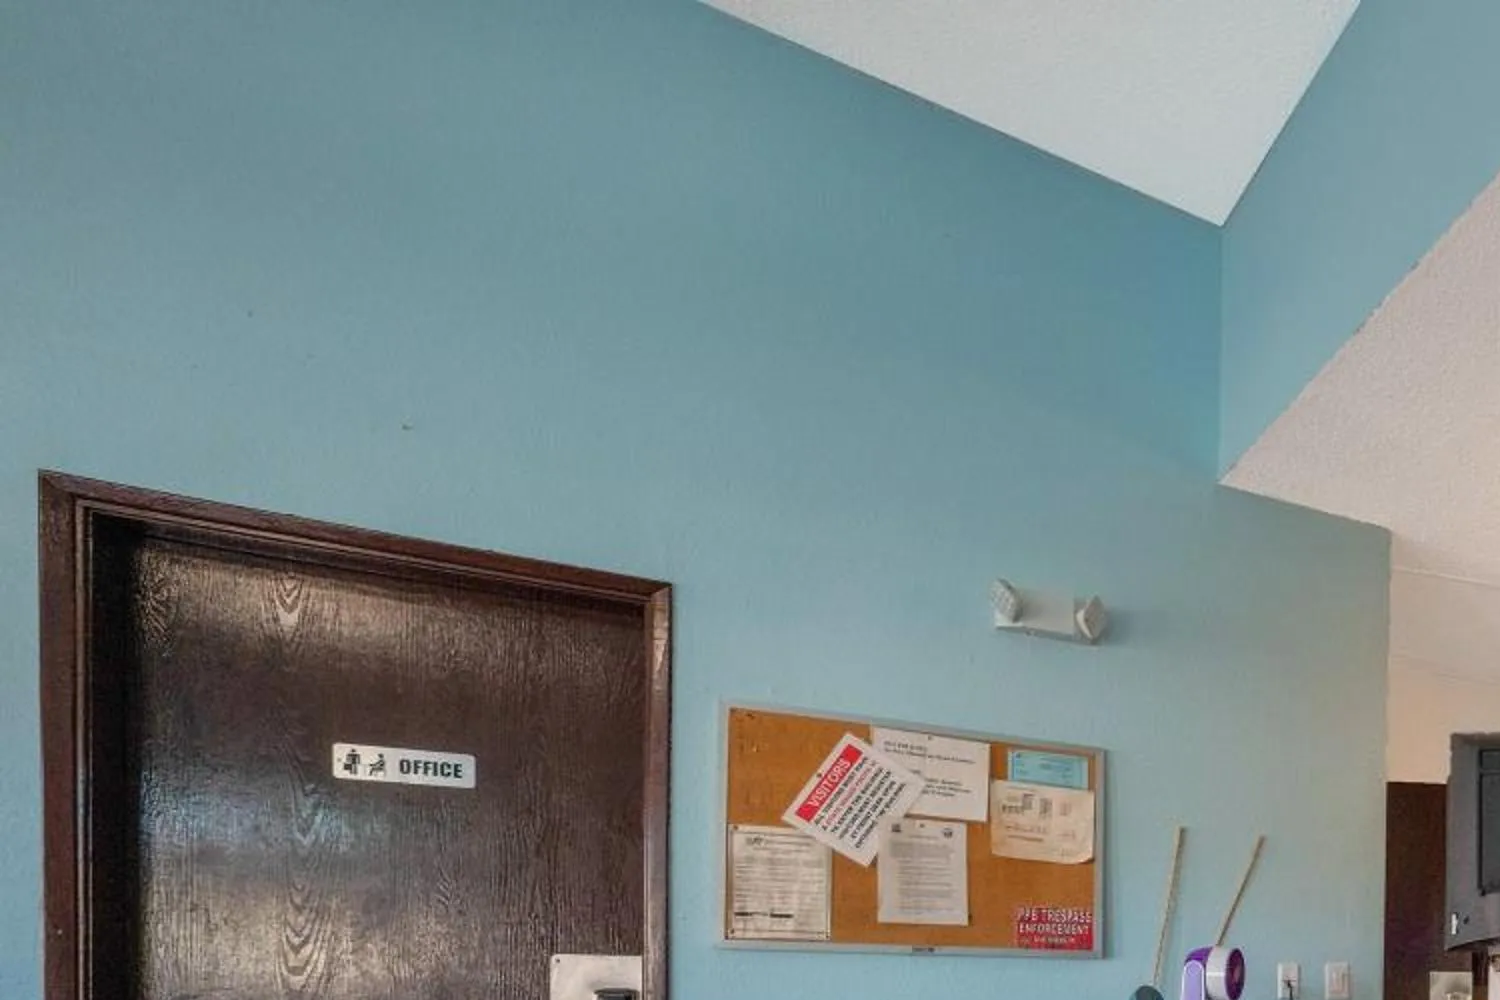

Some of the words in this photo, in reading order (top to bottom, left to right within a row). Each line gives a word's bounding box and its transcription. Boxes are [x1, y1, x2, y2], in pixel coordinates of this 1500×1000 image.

[399, 759, 463, 779] OFFICE
[807, 758, 852, 808] VISITORS
[1019, 922, 1089, 936] ENFORCEMENT
